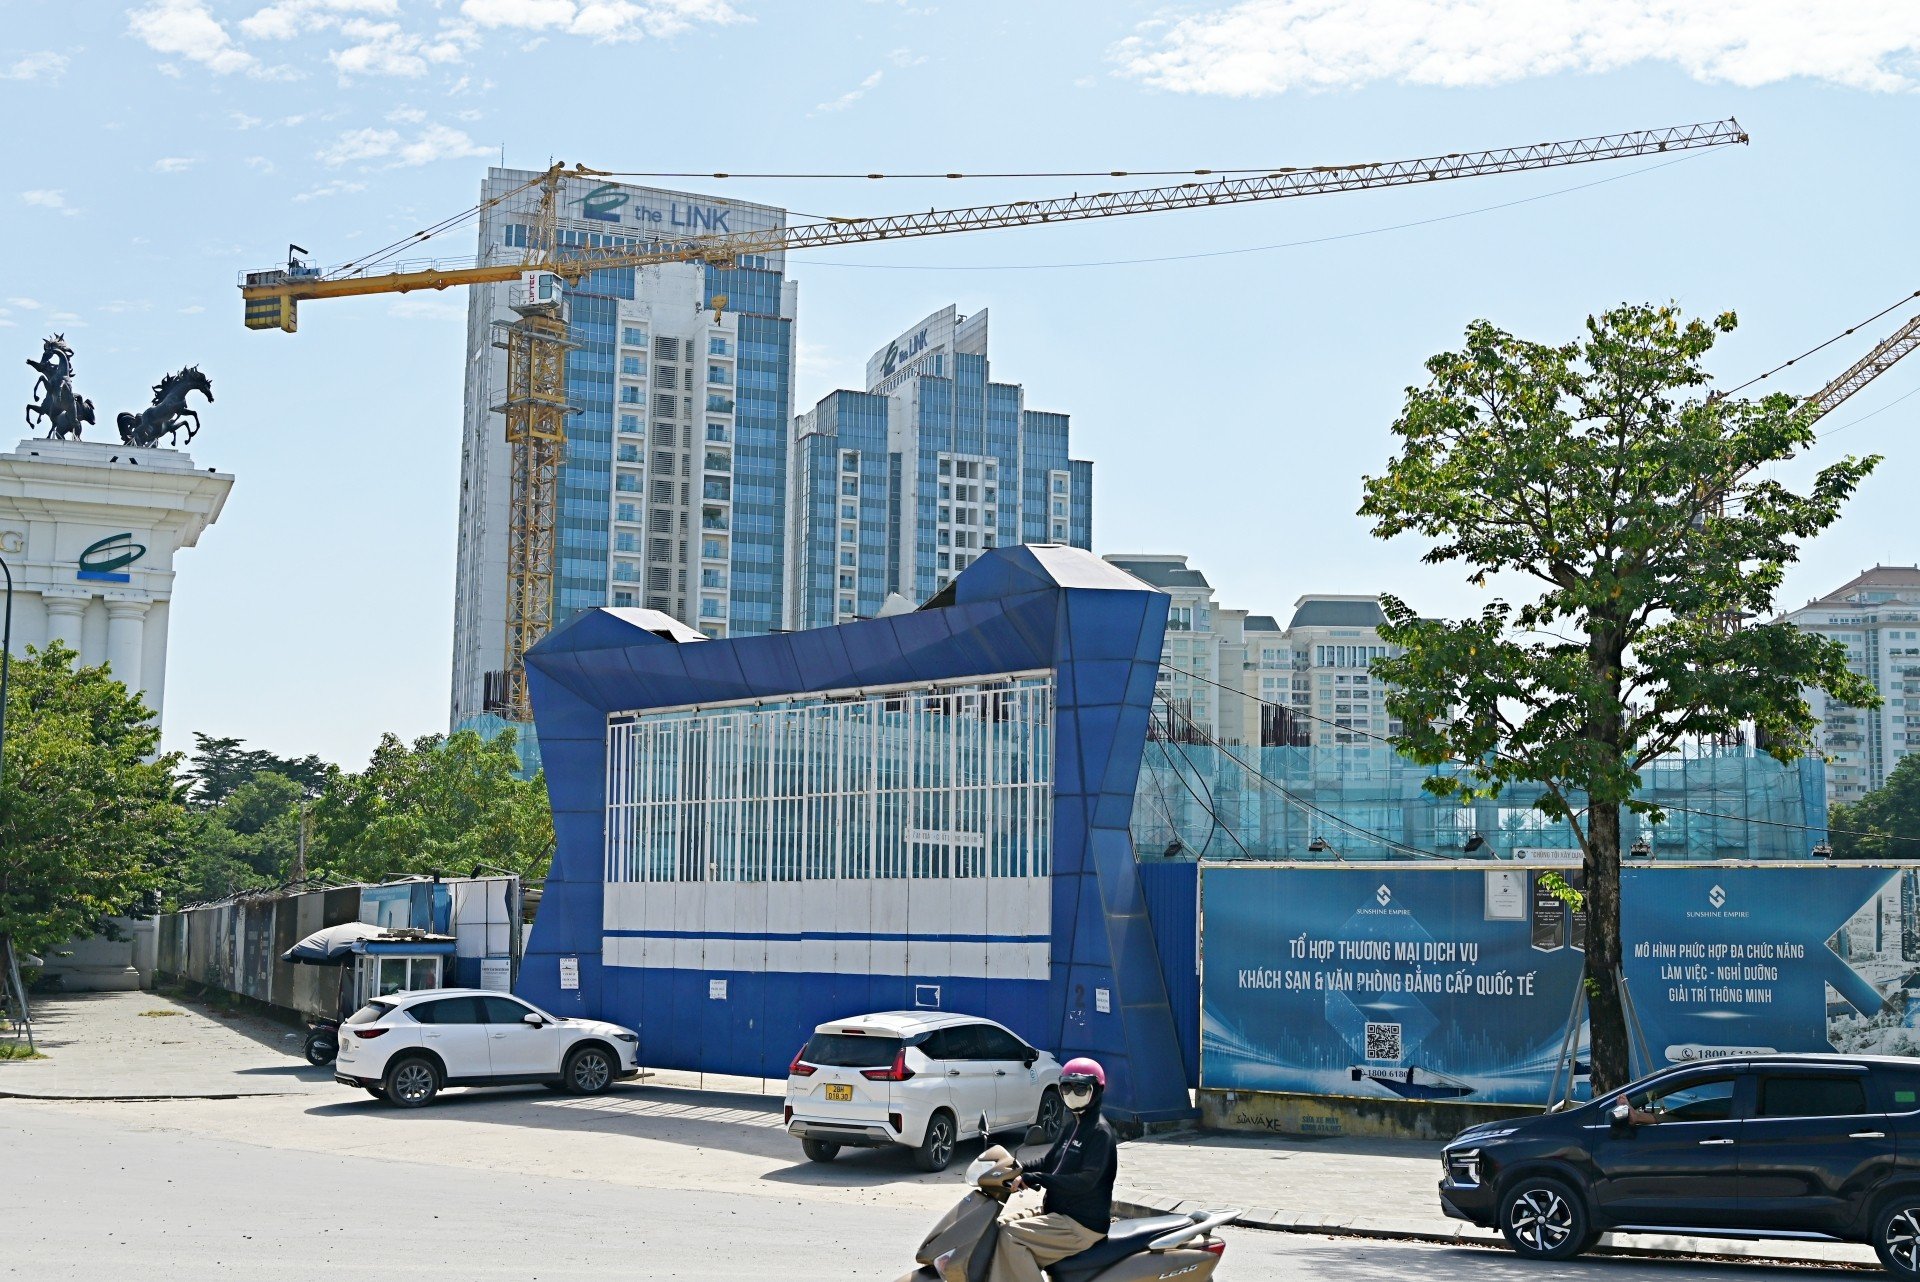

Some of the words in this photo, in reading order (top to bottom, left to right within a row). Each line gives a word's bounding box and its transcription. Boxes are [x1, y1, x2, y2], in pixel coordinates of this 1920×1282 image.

[635, 205, 662, 222] the
[671, 203, 730, 232] LINK
[909, 328, 927, 357] LINK
[1289, 932, 1307, 959] TỔ
[1310, 940, 1335, 963] HỢP
[1339, 940, 1391, 961] THƯƠNG
[1394, 942, 1420, 965] MẠI
[1424, 942, 1456, 965] DỊCH
[1459, 943, 1478, 966] VỤ
[1634, 941, 1650, 958] MÔ
[1652, 941, 1676, 958] HÌNH
[1679, 941, 1705, 958] PHỨC
[1708, 943, 1728, 961] HỢP
[1730, 944, 1744, 958] ĐA
[1746, 942, 1773, 959] CHỨC
[1776, 942, 1804, 959] NĂNG
[1238, 966, 1281, 989] KHÁCH
[1285, 970, 1311, 993] SẠN
[1315, 971, 1323, 990] &
[1326, 968, 1353, 991] VĂN
[1357, 969, 1401, 992] PHÒNG
[1405, 964, 1442, 993] ĐẲNG
[1445, 969, 1473, 994] CẤP
[1476, 970, 1513, 996] QUỐC
[1517, 970, 1537, 996] TẾ
[1661, 963, 1683, 980] LÀM
[1684, 963, 1708, 983] VIỆC
[1717, 963, 1741, 980] NGHỈ
[1744, 963, 1778, 981] DƯỠNG
[1668, 984, 1688, 1002] GIẢI
[1690, 986, 1707, 1002] TRÍ
[1709, 986, 1743, 1002] THÔNG
[1745, 988, 1772, 1003] MINH
[1367, 1069, 1387, 1077] 1800
[1266, 1117, 1281, 1131] XE
